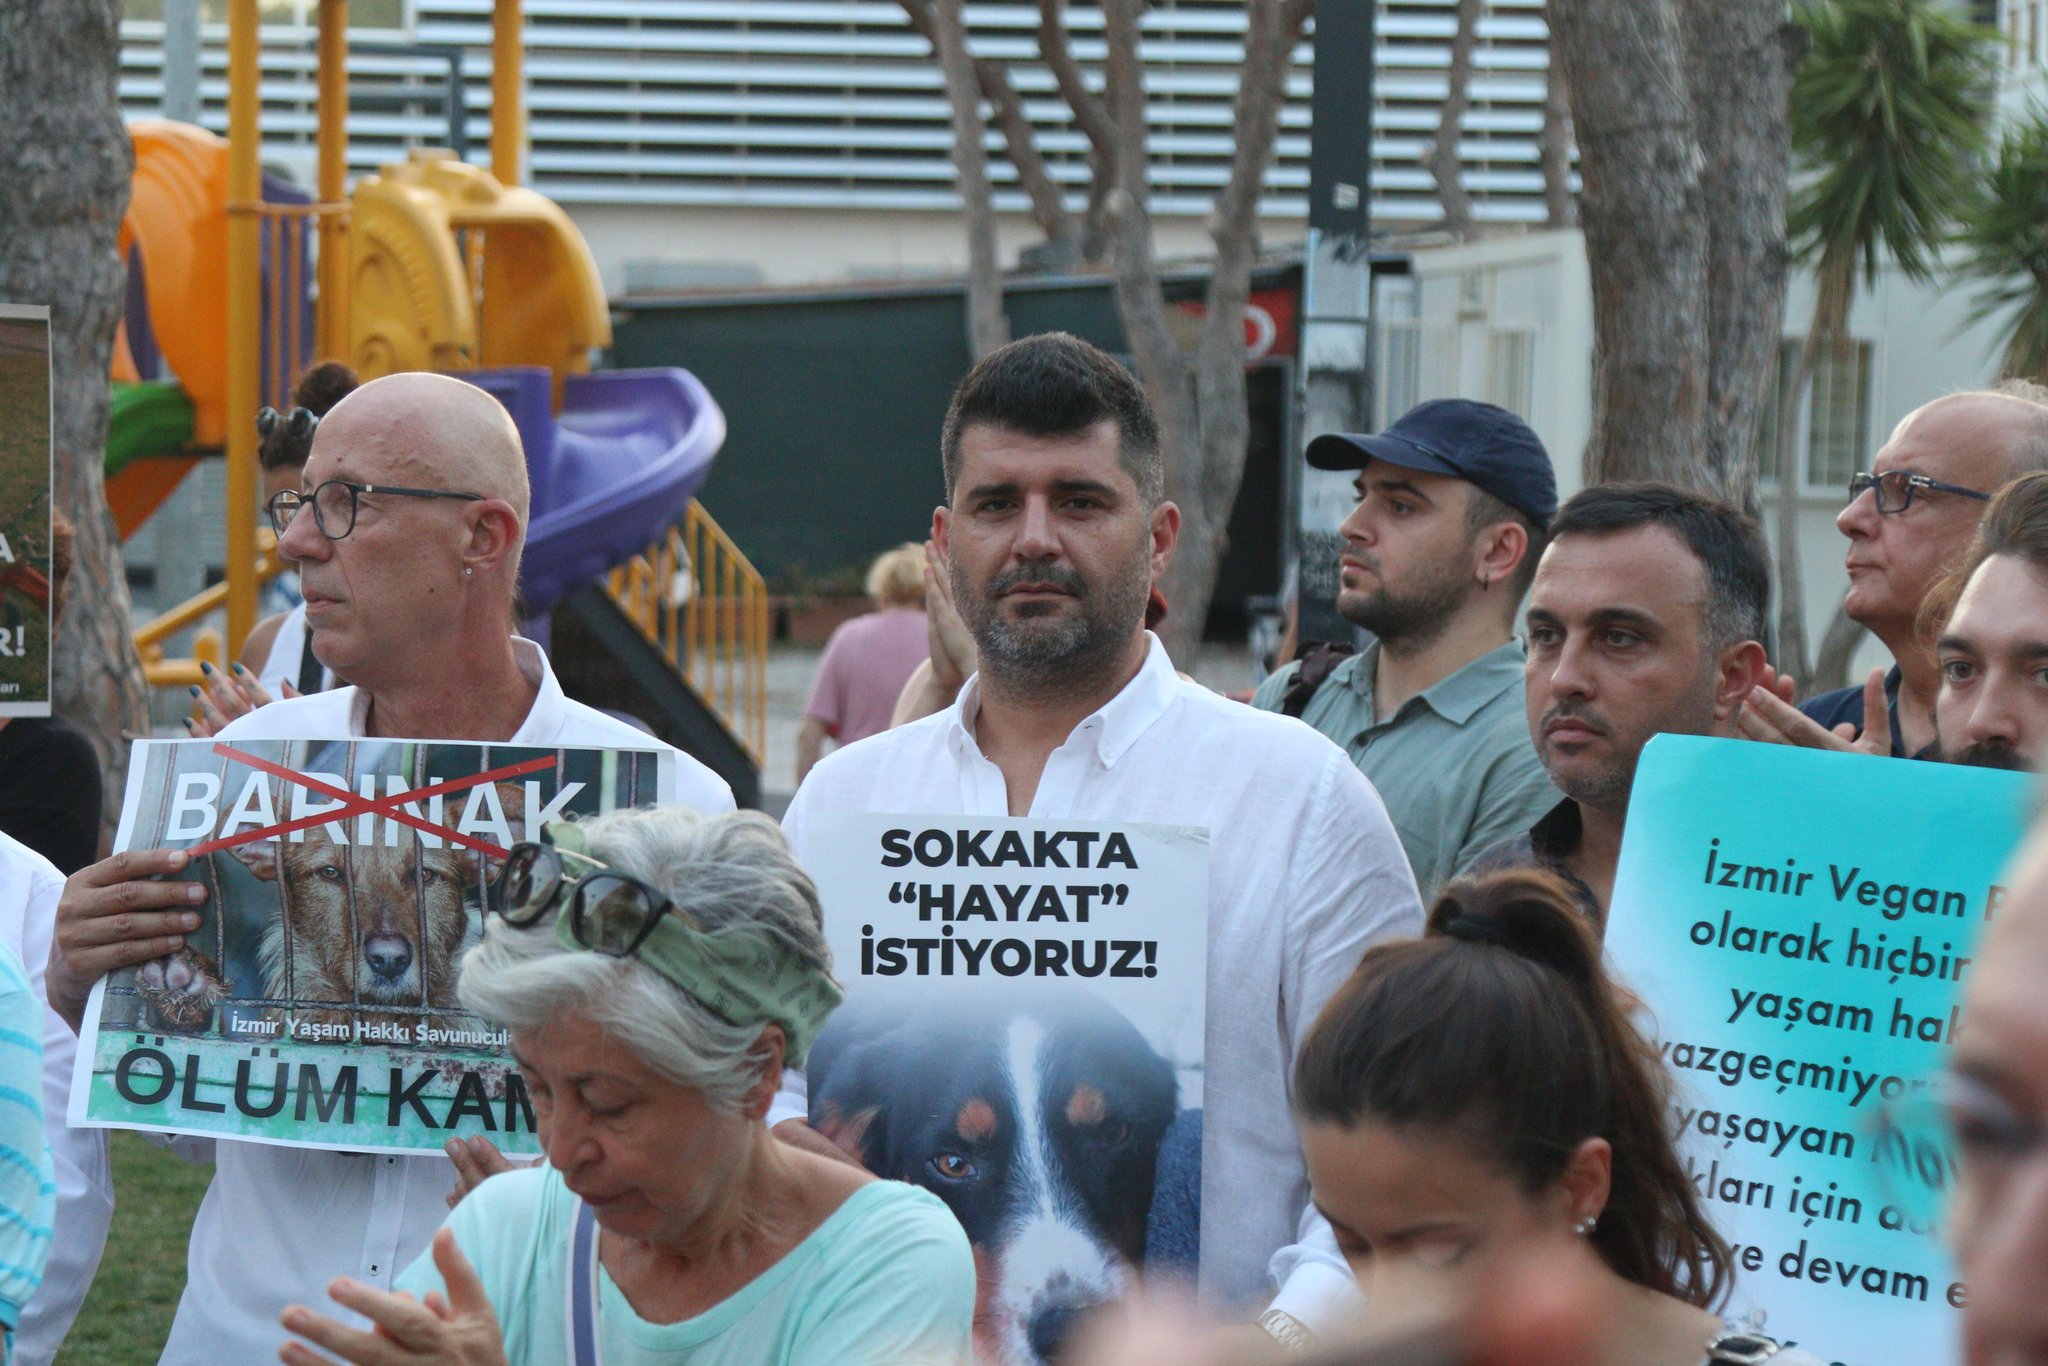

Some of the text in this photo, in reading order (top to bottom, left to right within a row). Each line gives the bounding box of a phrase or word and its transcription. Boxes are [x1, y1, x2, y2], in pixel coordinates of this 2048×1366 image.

[165, 770, 588, 851] BARINAK
[880, 829, 1139, 869] SOKAKTA
[888, 882, 1130, 923] “HAYAT”
[1704, 838, 1814, 896] İzmir
[1829, 864, 1967, 921] Vegan
[860, 924, 1159, 978] İSTİYORUZ!
[1690, 909, 1971, 985] olarak hiçbir
[231, 1010, 512, 1046] İzmir Yaşam Hakkı Savunucul
[1726, 988, 1964, 1046] yaşam hak
[115, 1035, 538, 1134] ÖLÜM KAM
[1673, 1104, 1855, 1158] yaşayan
[1686, 1156, 1774, 1209] kları
[1789, 1176, 1862, 1228] için
[1779, 1239, 1929, 1302] devam
